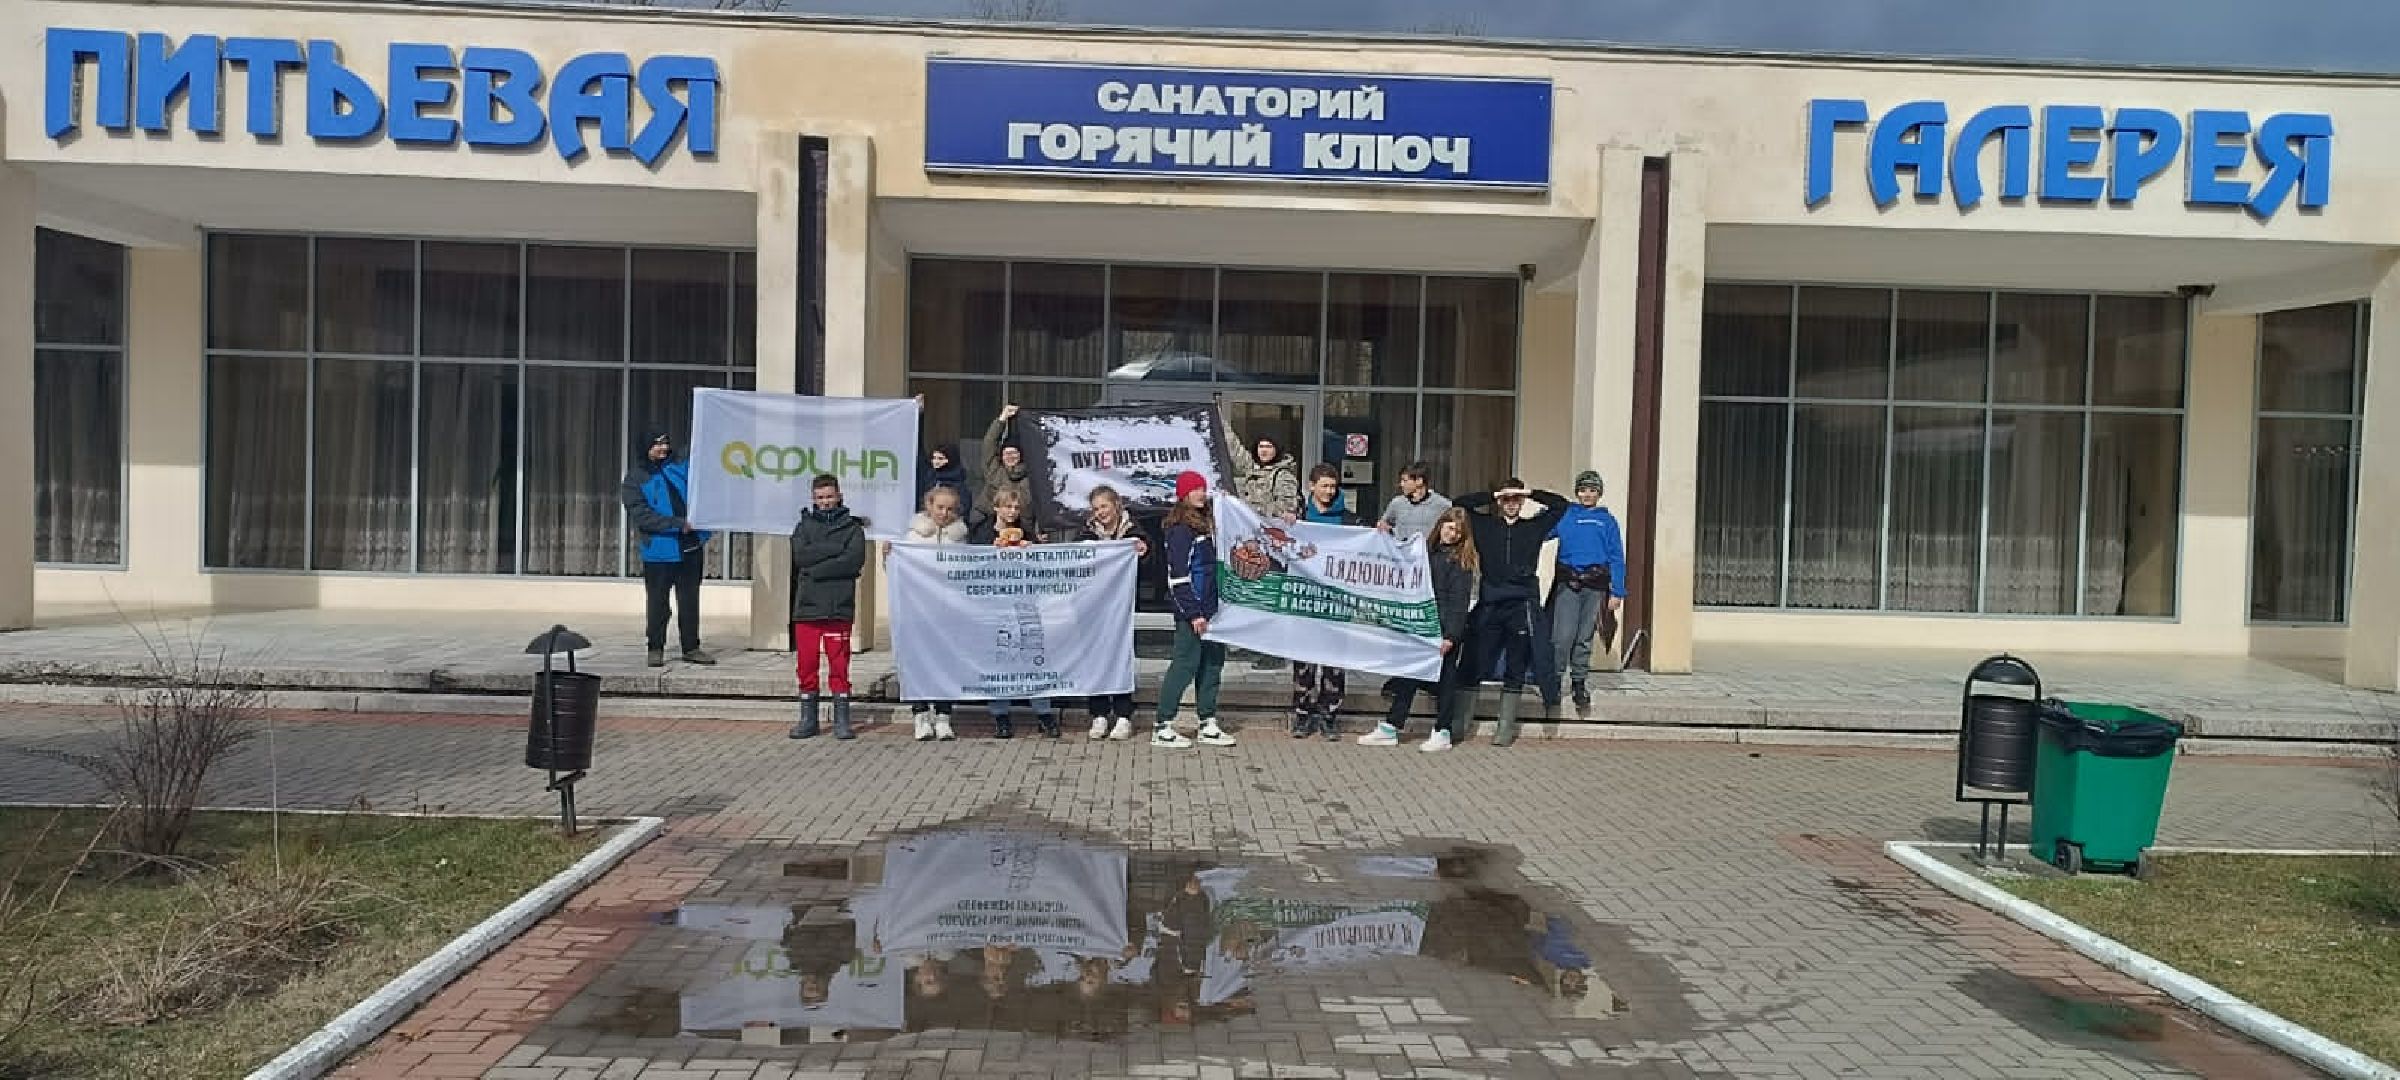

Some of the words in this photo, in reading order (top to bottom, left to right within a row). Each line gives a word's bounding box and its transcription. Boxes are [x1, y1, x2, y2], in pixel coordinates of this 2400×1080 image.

[46, 27, 718, 166] ПИТЬЕВАЯ
[1097, 80, 1385, 122] САНАТОРИЙ
[1007, 122, 1271, 168] ГОРЯЧИЙ
[1303, 133, 1471, 174] КЛЮЧ
[1806, 98, 2333, 218] ГАЛЕРЕЯ
[1071, 447, 1192, 471] ПУТЕШЕСТВИЯ
[947, 569, 996, 580] СДЕЛАЕМ
[999, 568, 1022, 580] НАШ
[1025, 568, 1059, 579] РАЙОН
[999, 551, 1021, 561] ООО
[1324, 555, 1405, 589] ДЯДЮШКА
